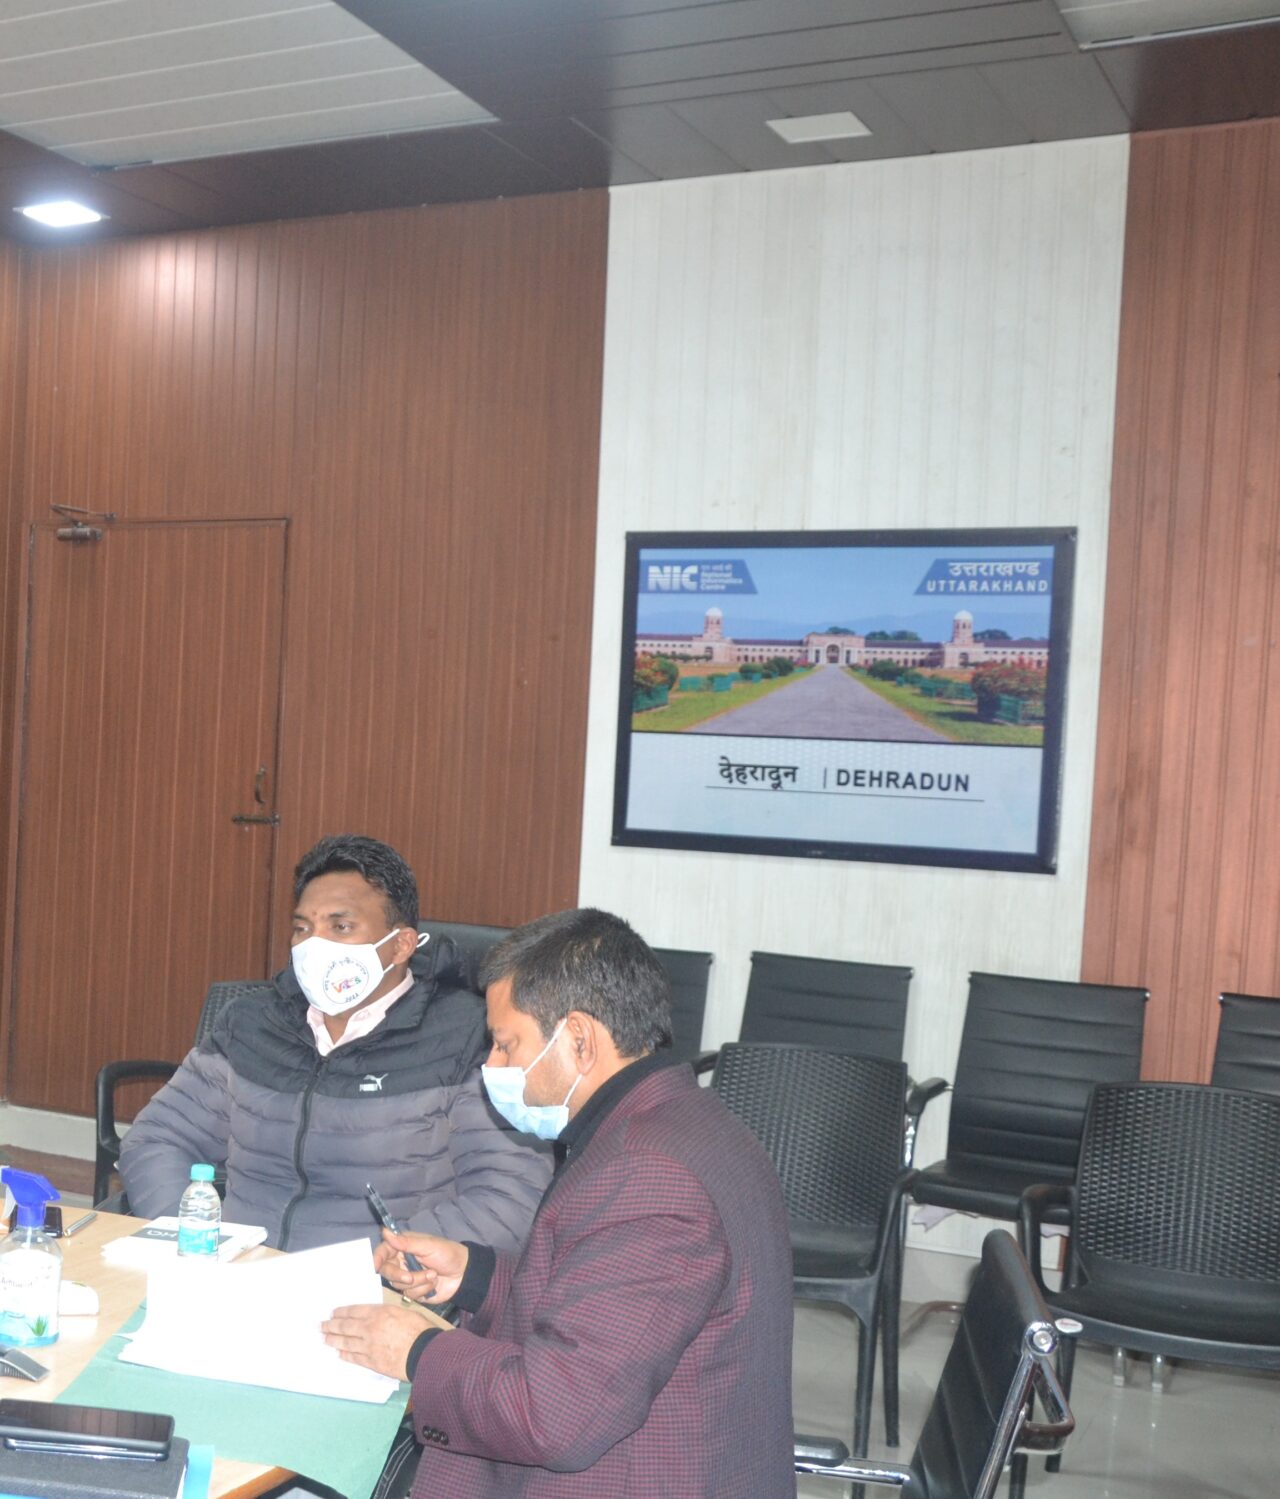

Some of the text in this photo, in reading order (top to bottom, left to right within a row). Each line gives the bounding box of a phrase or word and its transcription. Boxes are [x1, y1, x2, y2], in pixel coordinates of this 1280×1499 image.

[647, 565, 699, 591] NIC
[948, 561, 1040, 576] उत्तराखण्ड
[926, 579, 1049, 593] UTTARAKHAND
[718, 755, 799, 790] देहरादून
[836, 768, 970, 792] DEHRADUN
